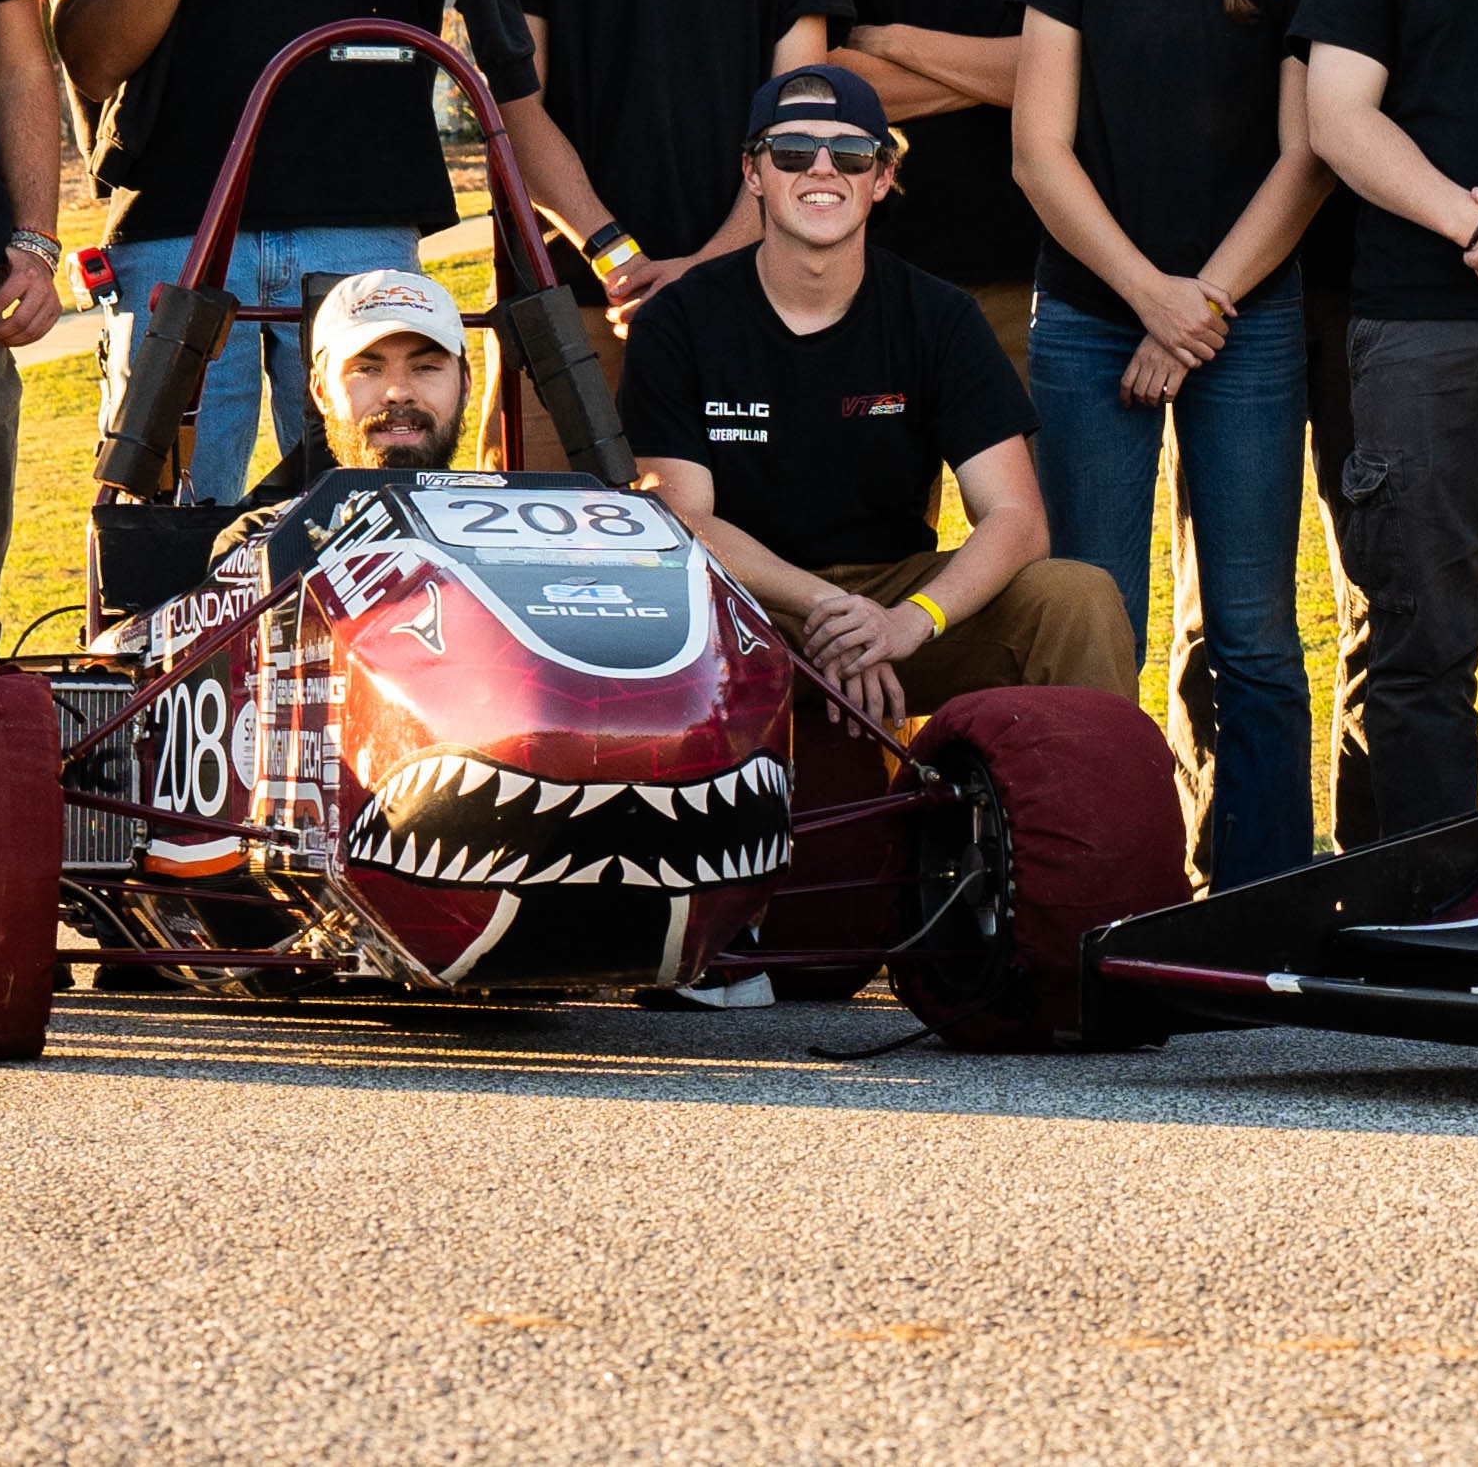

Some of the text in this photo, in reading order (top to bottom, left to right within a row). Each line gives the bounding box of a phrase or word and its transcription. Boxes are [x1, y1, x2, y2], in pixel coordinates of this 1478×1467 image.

[704, 400, 770, 418] GILLIG
[707, 427, 768, 444] ATERPILLAR
[448, 498, 646, 537] 208
[526, 605, 669, 618] GILLIG
[152, 678, 228, 818] 208
